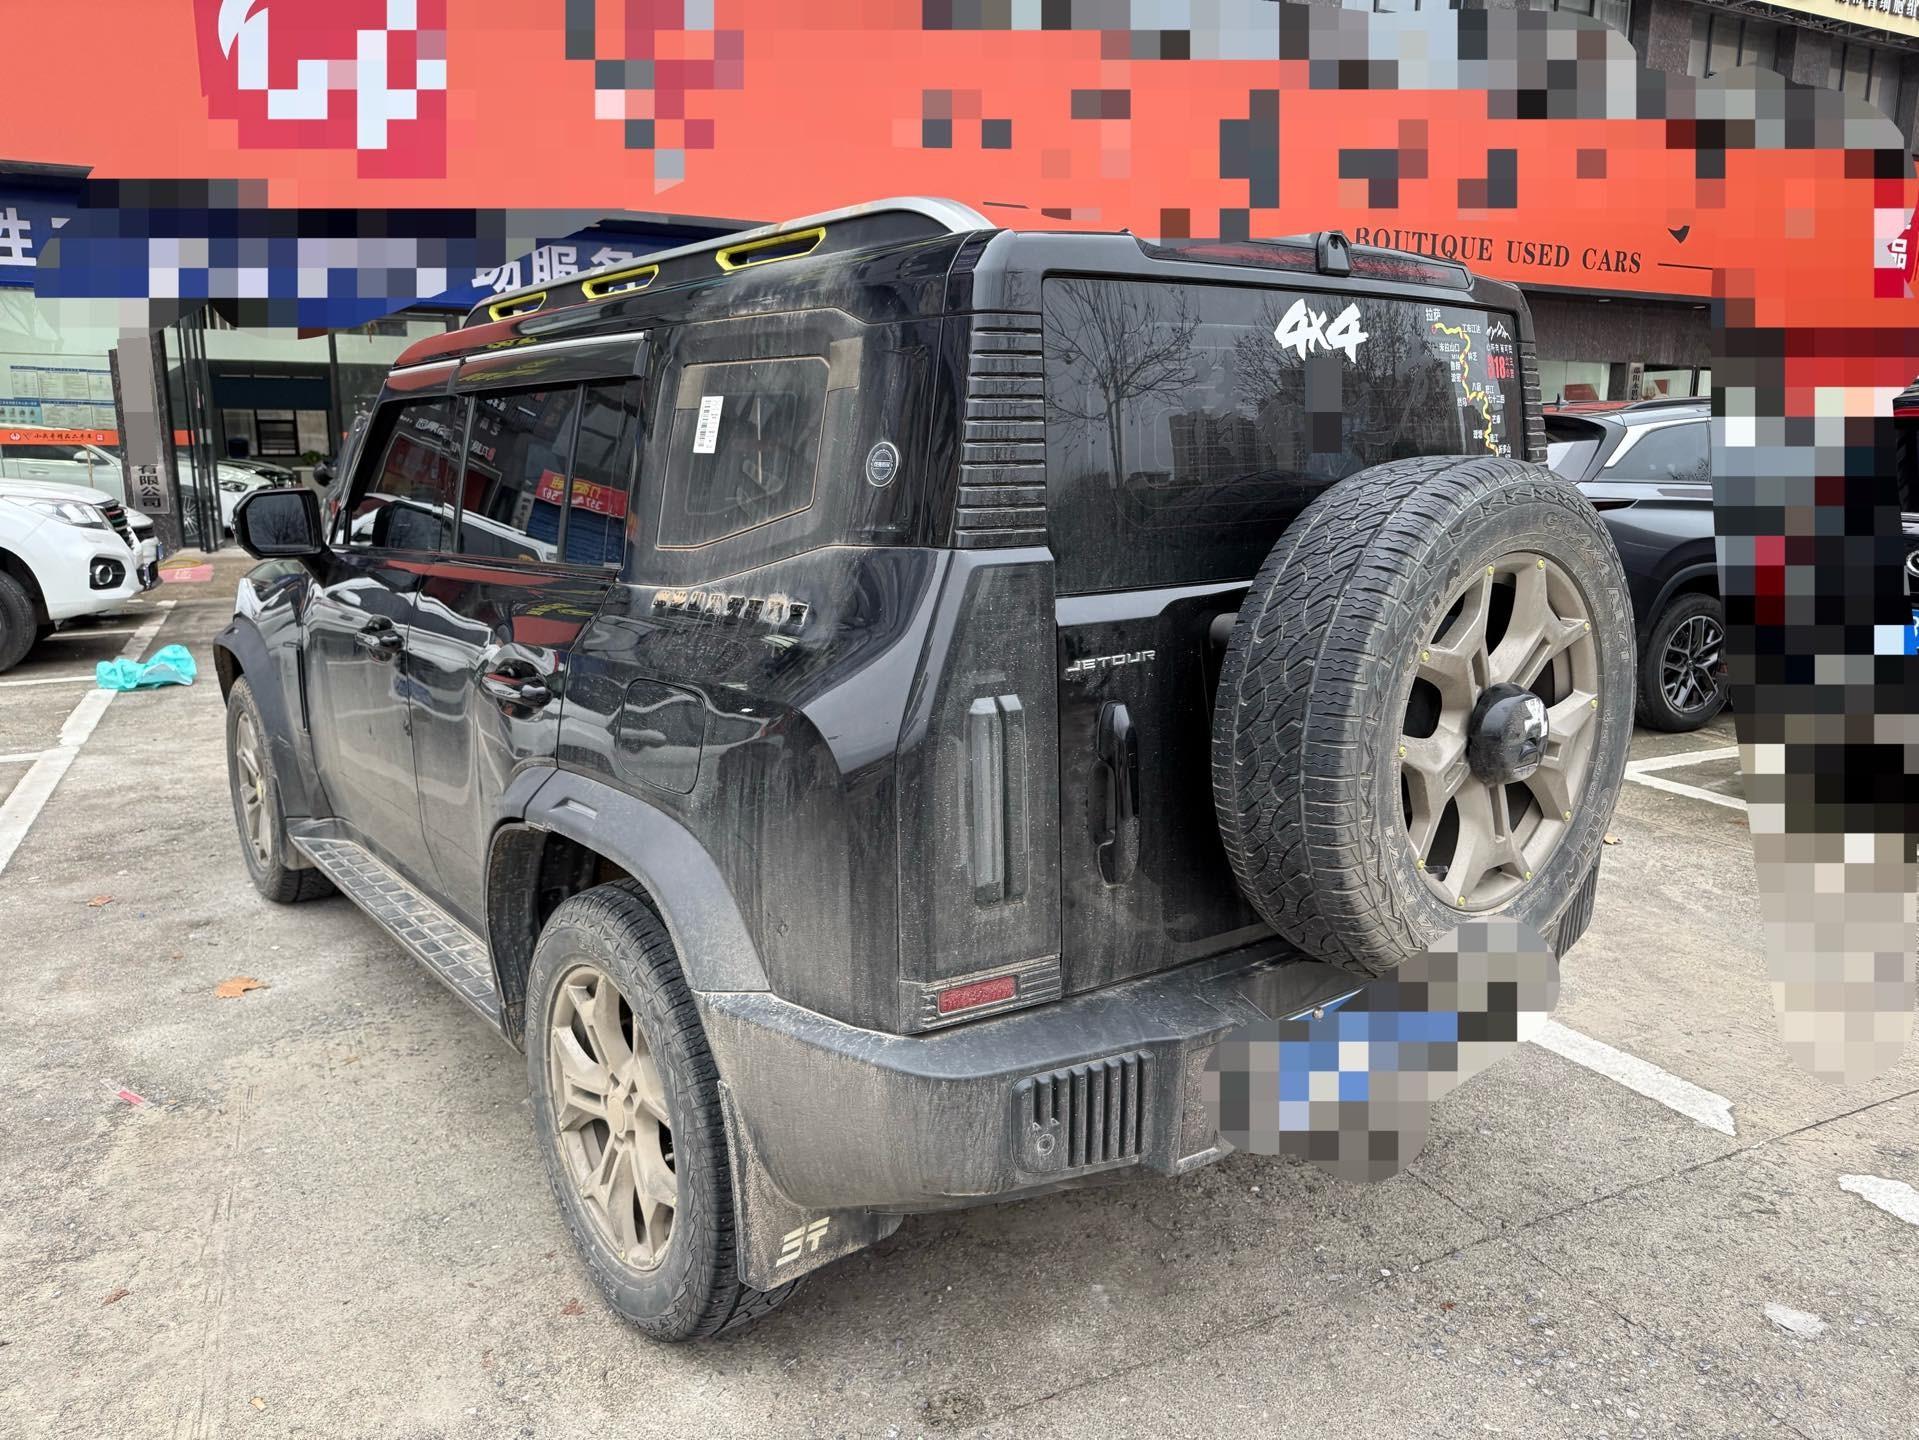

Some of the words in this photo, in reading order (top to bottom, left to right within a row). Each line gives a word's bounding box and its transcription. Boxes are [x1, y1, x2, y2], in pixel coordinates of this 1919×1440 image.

[1355, 227, 1493, 261] BOUTIQUE
[1507, 240, 1570, 267] USED
[1582, 248, 1642, 274] CARS
[1065, 650, 1157, 673] JETOUR
